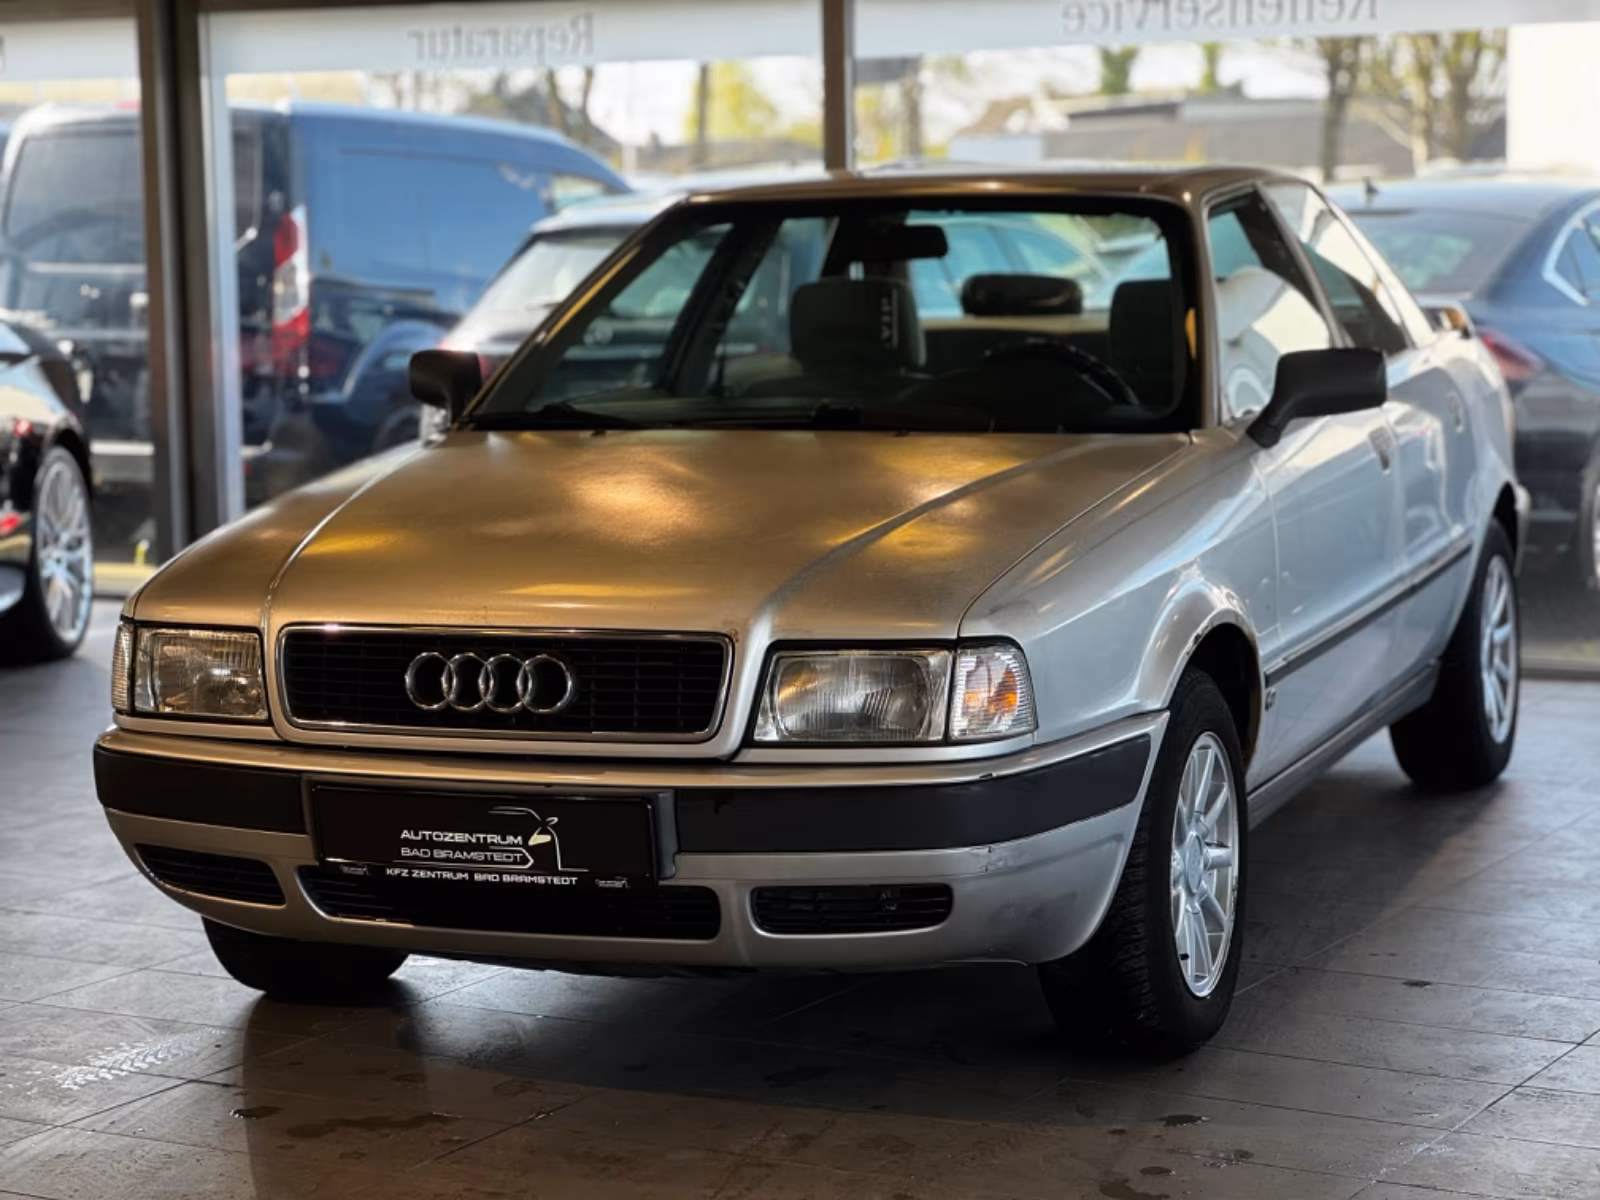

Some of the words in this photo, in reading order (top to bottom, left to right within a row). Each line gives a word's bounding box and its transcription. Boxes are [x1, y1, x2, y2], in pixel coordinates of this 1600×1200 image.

[400, 829, 523, 846] AUTOZENTRUM
[401, 847, 431, 859] BAD
[432, 849, 523, 863] BRAMSTEDT
[386, 867, 410, 877] KFZ
[411, 869, 469, 881] ZENTRUM
[474, 872, 500, 883] BAD
[502, 873, 579, 886] BRAMSTEDT
